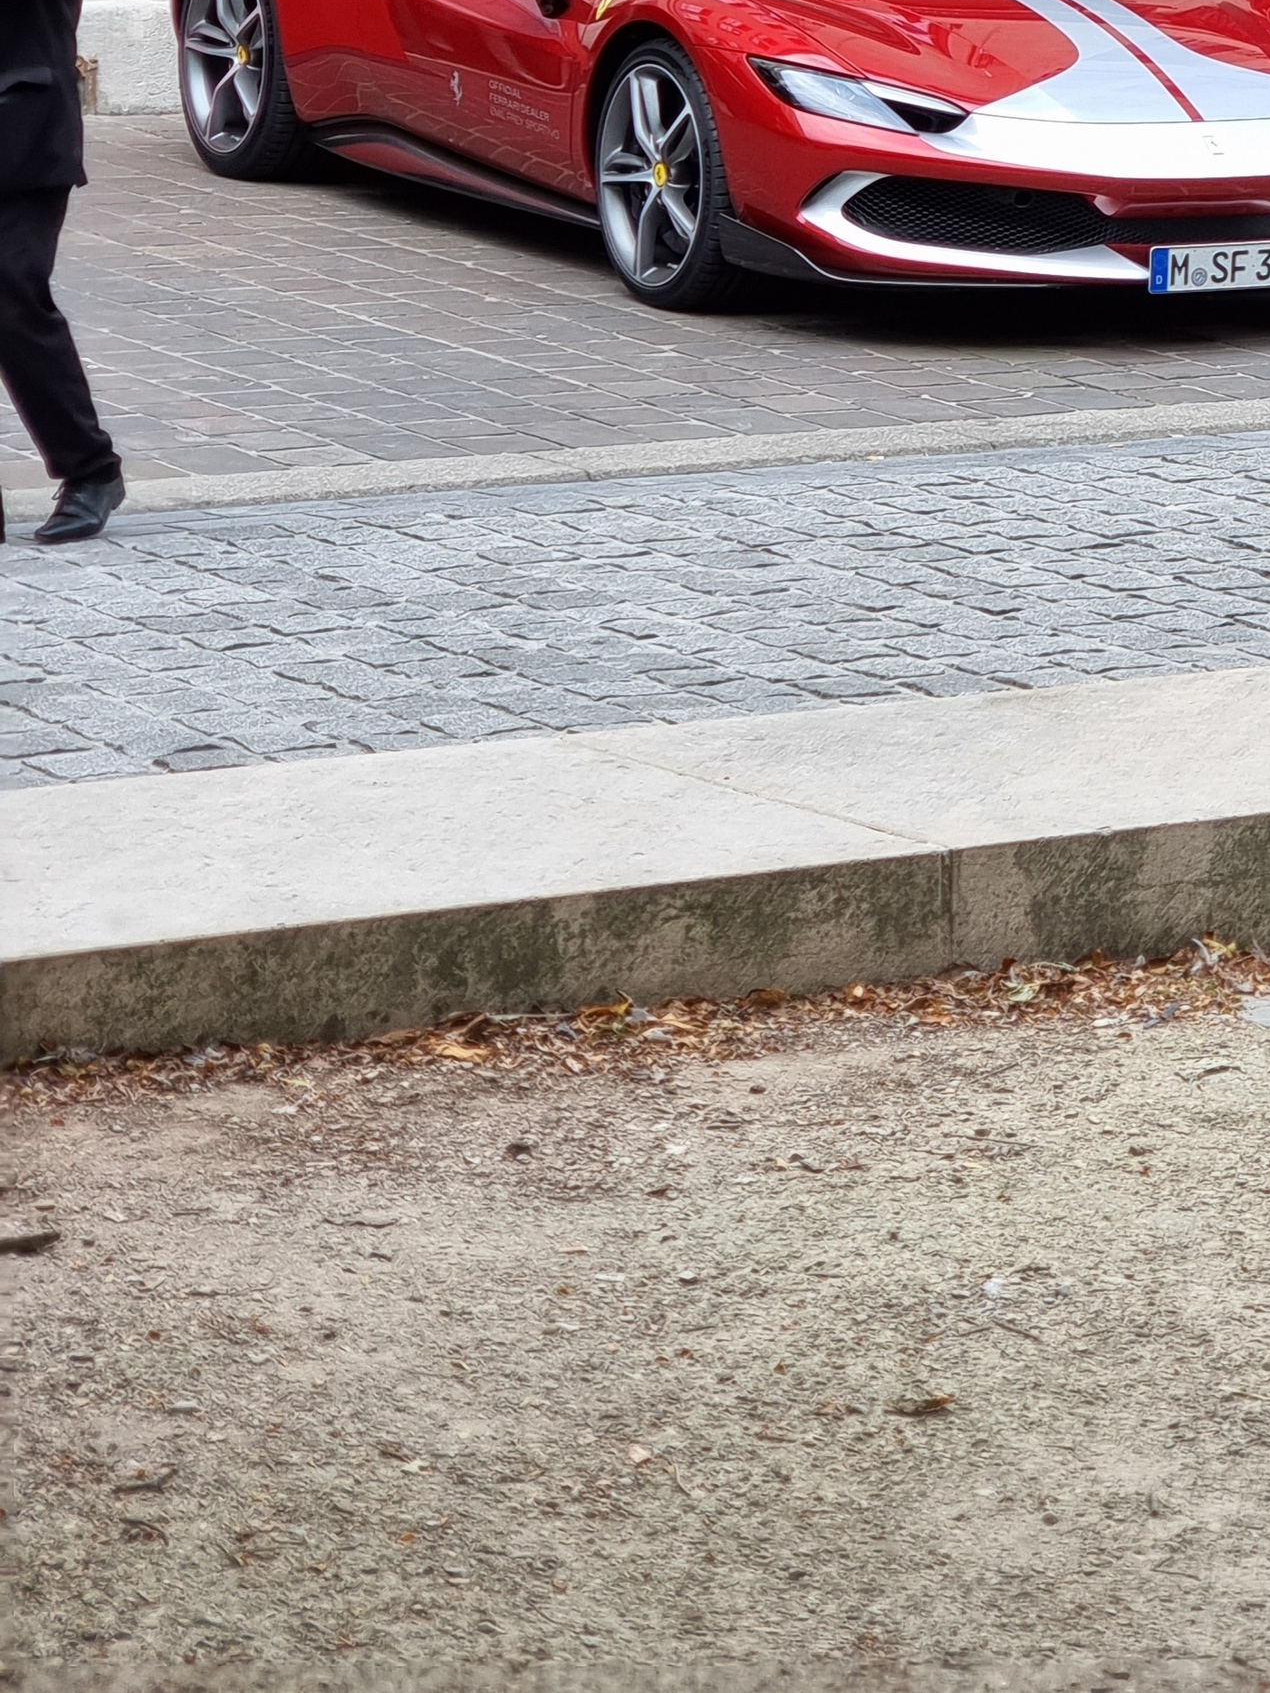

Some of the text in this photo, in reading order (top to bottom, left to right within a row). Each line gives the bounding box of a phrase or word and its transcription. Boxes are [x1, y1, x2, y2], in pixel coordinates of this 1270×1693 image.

[489, 80, 522, 99] OFFICIAL
[521, 103, 549, 122] DEALER
[1156, 275, 1163, 284] D
[1170, 253, 1190, 286] M
[1211, 250, 1249, 284] SF
